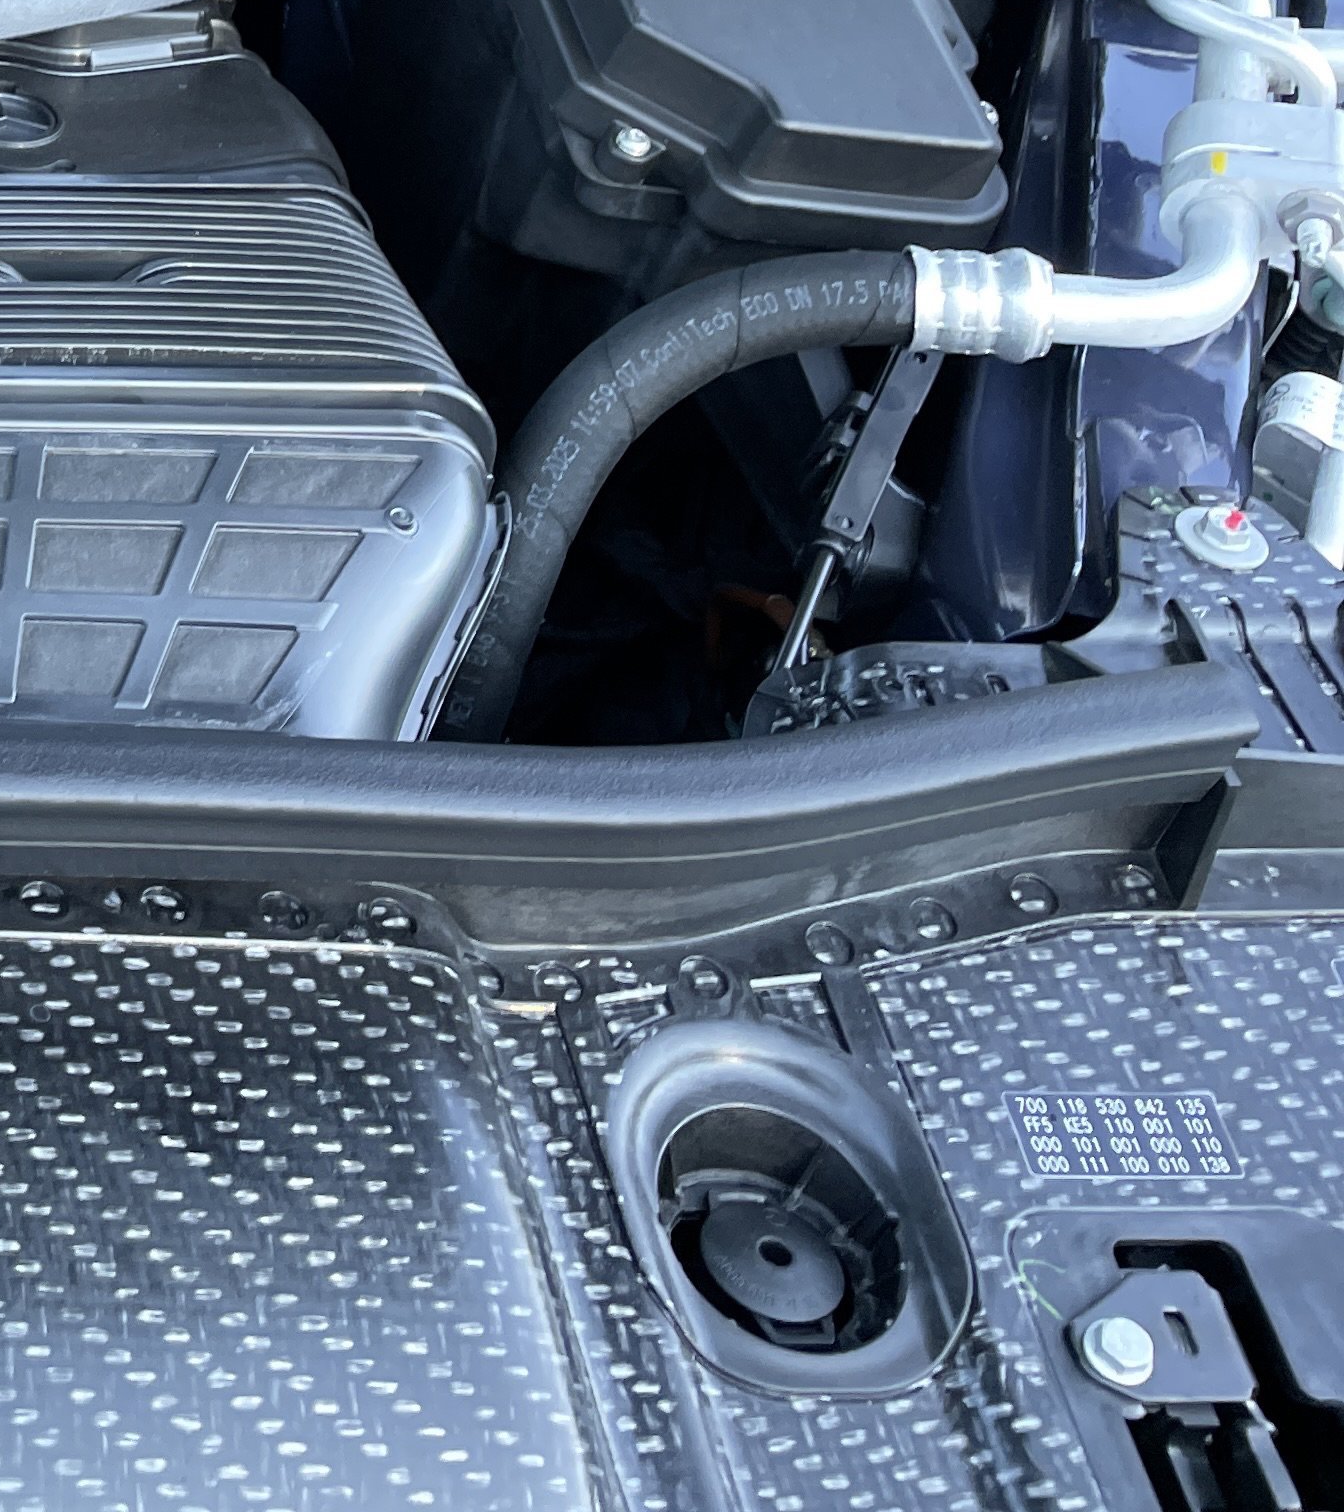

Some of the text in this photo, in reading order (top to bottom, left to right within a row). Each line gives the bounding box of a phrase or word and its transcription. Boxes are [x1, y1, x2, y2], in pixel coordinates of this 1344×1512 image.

[740, 291, 778, 321] ECO
[819, 279, 870, 307] 17.5
[1014, 1096, 1207, 1116] 700 118 530 842 135
[1023, 1116, 1213, 1135] FF5 KE5 110 001 101
[1030, 1135, 1223, 1155] 000 101 001 000 110
[1037, 1155, 1070, 1174] 000
[1079, 1155, 1110, 1173] 111
[1119, 1155, 1151, 1174] 100
[1158, 1155, 1191, 1174] 010
